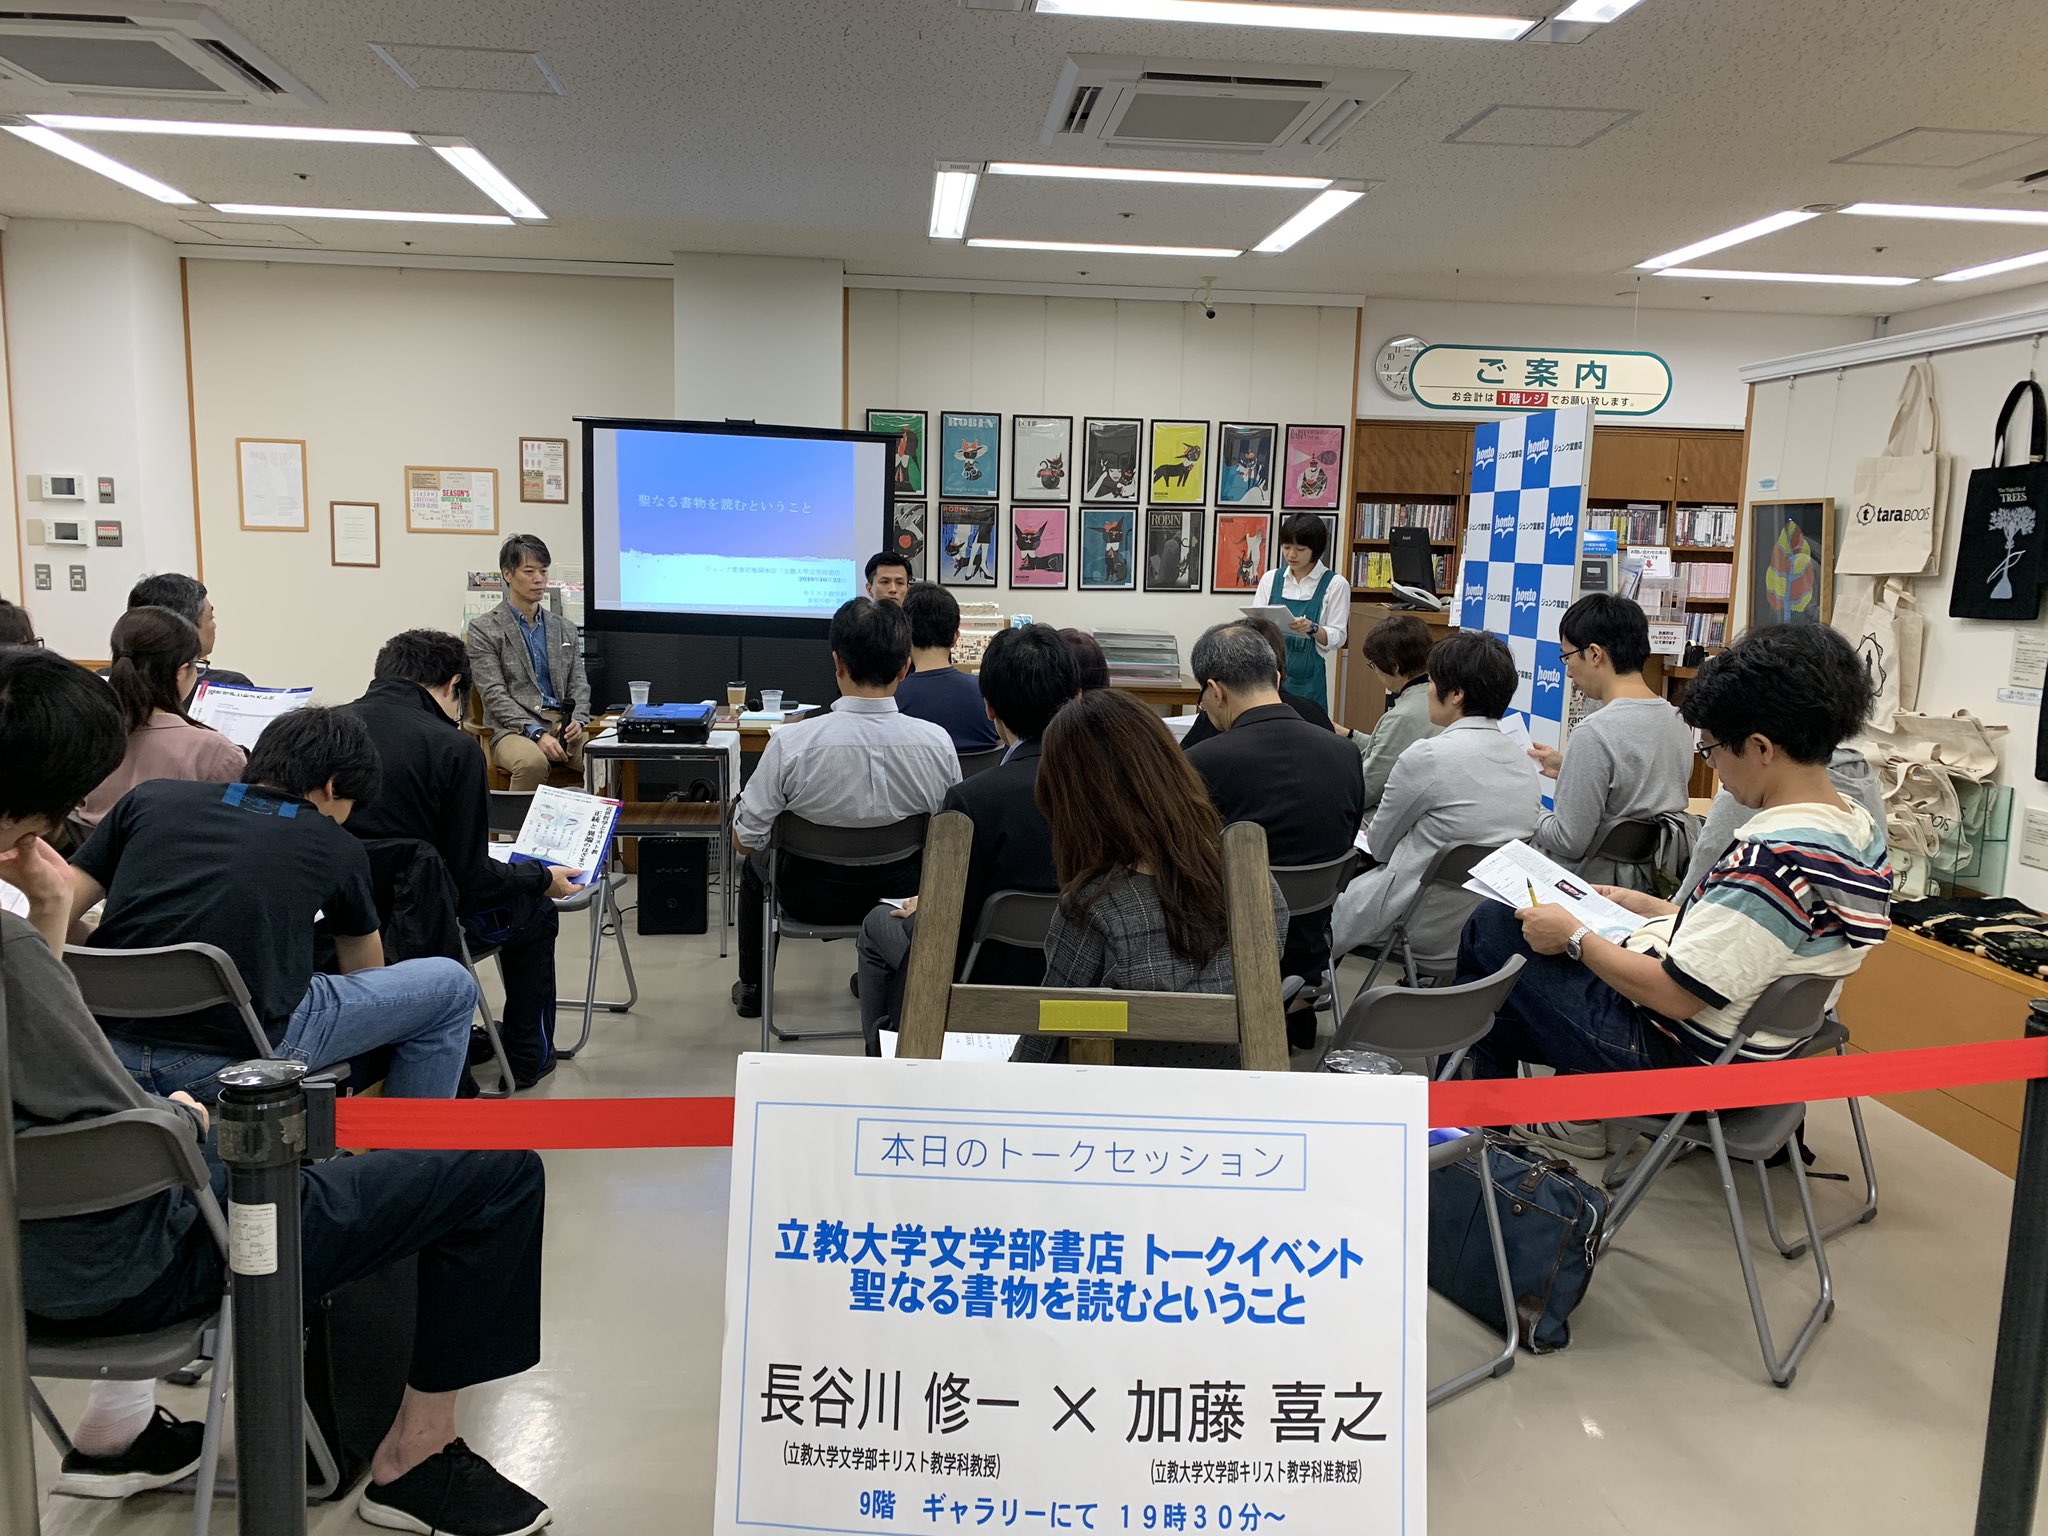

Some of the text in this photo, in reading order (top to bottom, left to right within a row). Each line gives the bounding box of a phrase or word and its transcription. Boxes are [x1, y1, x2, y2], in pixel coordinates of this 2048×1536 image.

[1387, 352, 1395, 360] 10
[1383, 363, 1390, 371] 9
[1476, 357, 1608, 390] ご案内
[1401, 384, 1408, 392] 6
[1475, 445, 1495, 462] honto
[1526, 437, 1550, 456] honto
[1554, 441, 1583, 453] ジュンク堂書店
[637, 493, 813, 515] 聖なる書物を読むということ
[1999, 492, 2028, 503] TREES
[1151, 513, 1182, 526] ROBIN
[1494, 514, 1515, 529] honto
[1549, 512, 1574, 529] honto
[1465, 582, 1484, 597] honto
[1515, 587, 1537, 602] honto
[1541, 599, 1570, 609] ジュンク堂書店
[1537, 664, 1561, 683] honto
[880, 1131, 1284, 1177] 本日のトークセッション
[774, 1217, 1364, 1280] 立教大学文学部書店 トークイベント
[849, 1267, 1306, 1326] 聖なる書物を読むということ
[760, 1362, 902, 1431] 長谷川
[924, 1371, 1020, 1435] 修一
[1125, 1378, 1246, 1443] 加藤
[1270, 1380, 1388, 1443] 喜之
[859, 1489, 897, 1521] 9階
[922, 1493, 1099, 1528] ギャラリーにて
